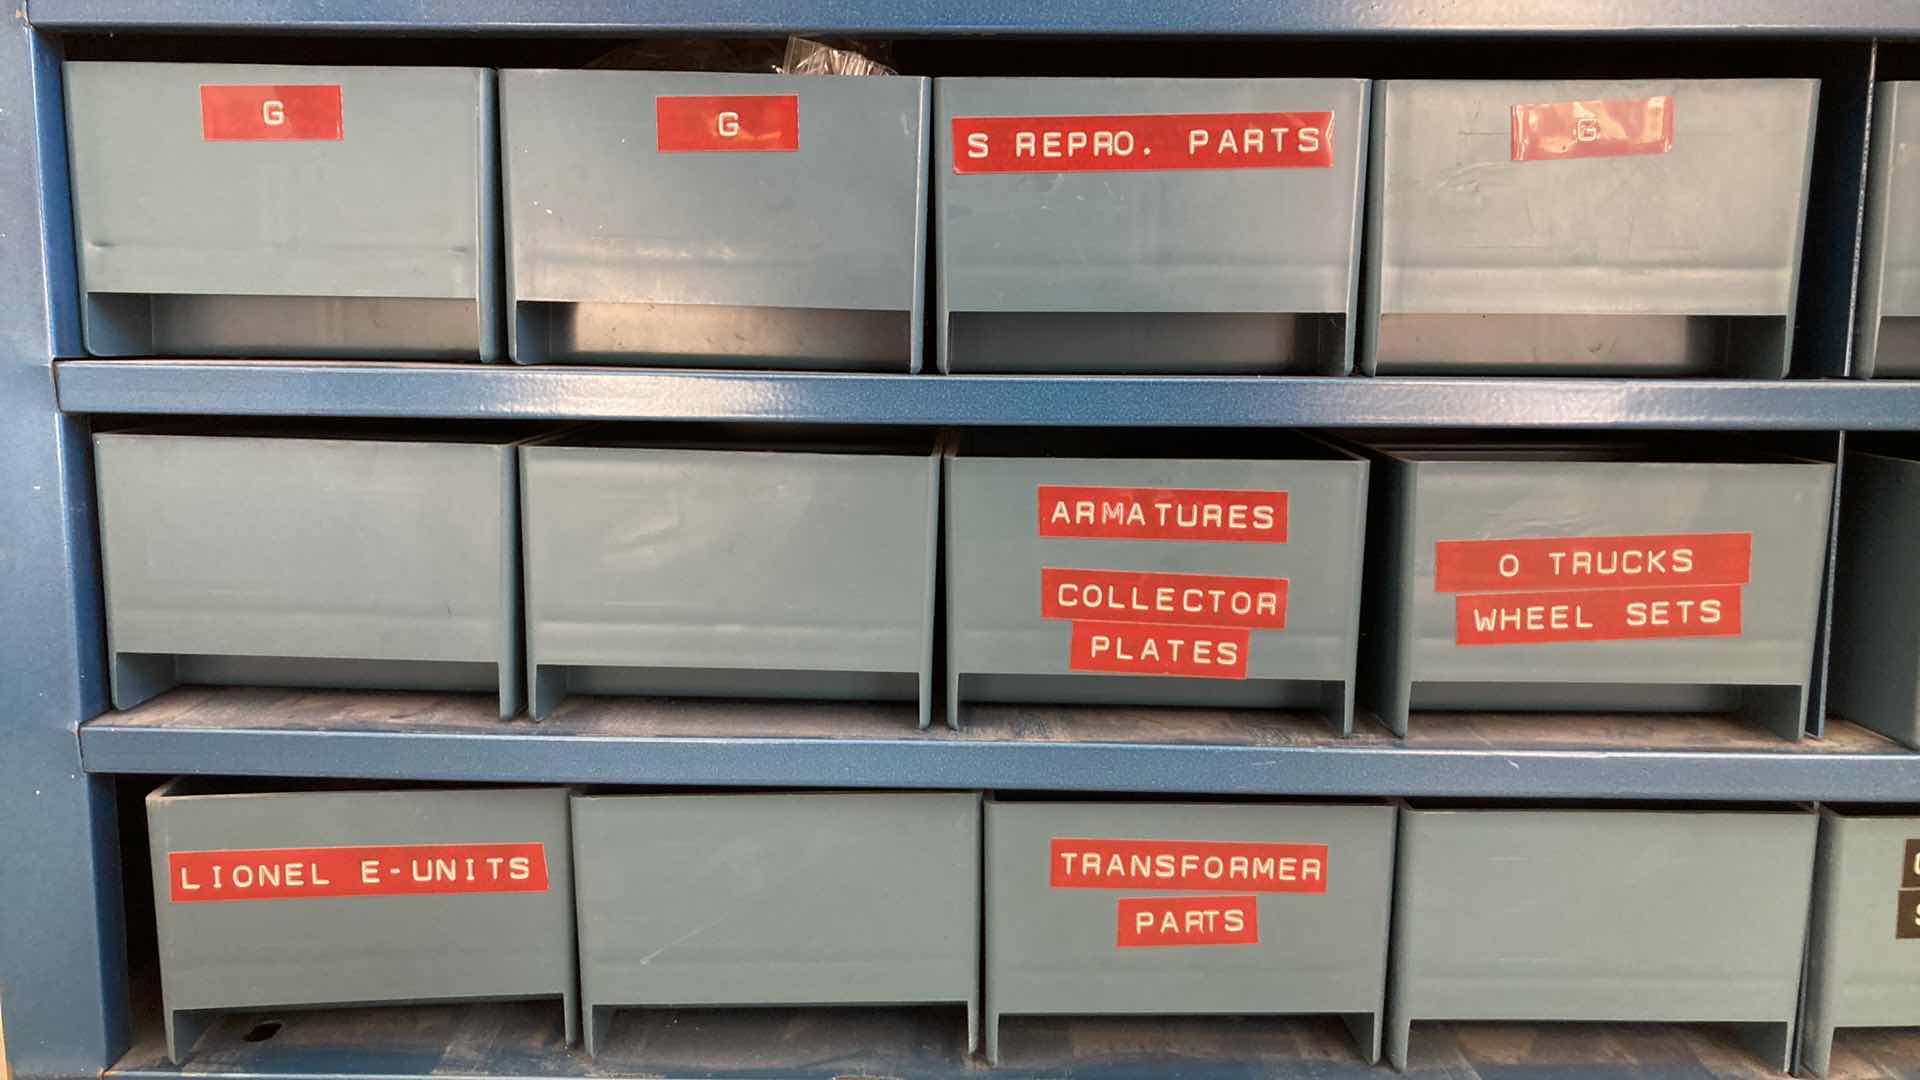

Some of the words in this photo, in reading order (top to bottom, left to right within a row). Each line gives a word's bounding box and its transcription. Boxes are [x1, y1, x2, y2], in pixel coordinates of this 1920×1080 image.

[262, 99, 285, 127] G
[717, 111, 741, 138] G
[967, 133, 989, 158] S
[1016, 131, 1152, 158] REPRO.
[1188, 126, 1321, 155] PARTS
[1575, 116, 1602, 143] G
[1051, 500, 1275, 529] ARMATURES
[1548, 548, 1694, 576] TRUCKS
[1058, 583, 1278, 616] COLLECTOR
[1473, 605, 1594, 632] WHEEL
[1625, 599, 1722, 626] SETS
[1090, 635, 1239, 666] PLATES
[181, 862, 331, 890] LIONEL
[361, 856, 531, 884] E-UNITS
[1060, 852, 1322, 881] TRANSFORMER
[1135, 909, 1245, 935] PARTS
